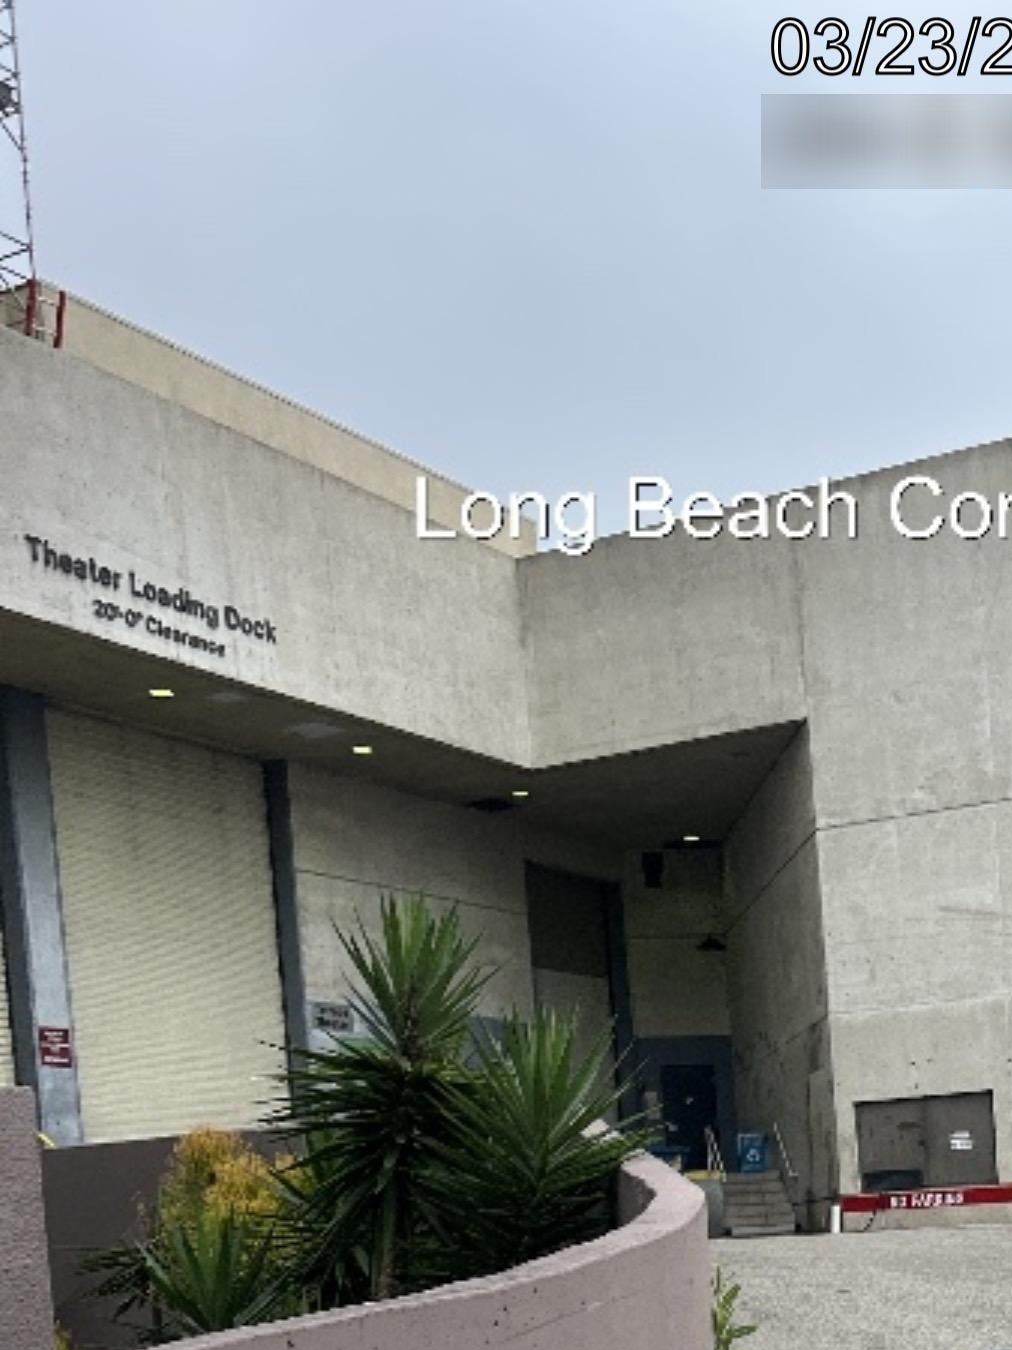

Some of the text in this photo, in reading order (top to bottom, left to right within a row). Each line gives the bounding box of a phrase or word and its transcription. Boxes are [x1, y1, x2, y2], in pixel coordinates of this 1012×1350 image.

[24, 533, 277, 644] Theater Loading Dock
[146, 614, 225, 658] Clearance
